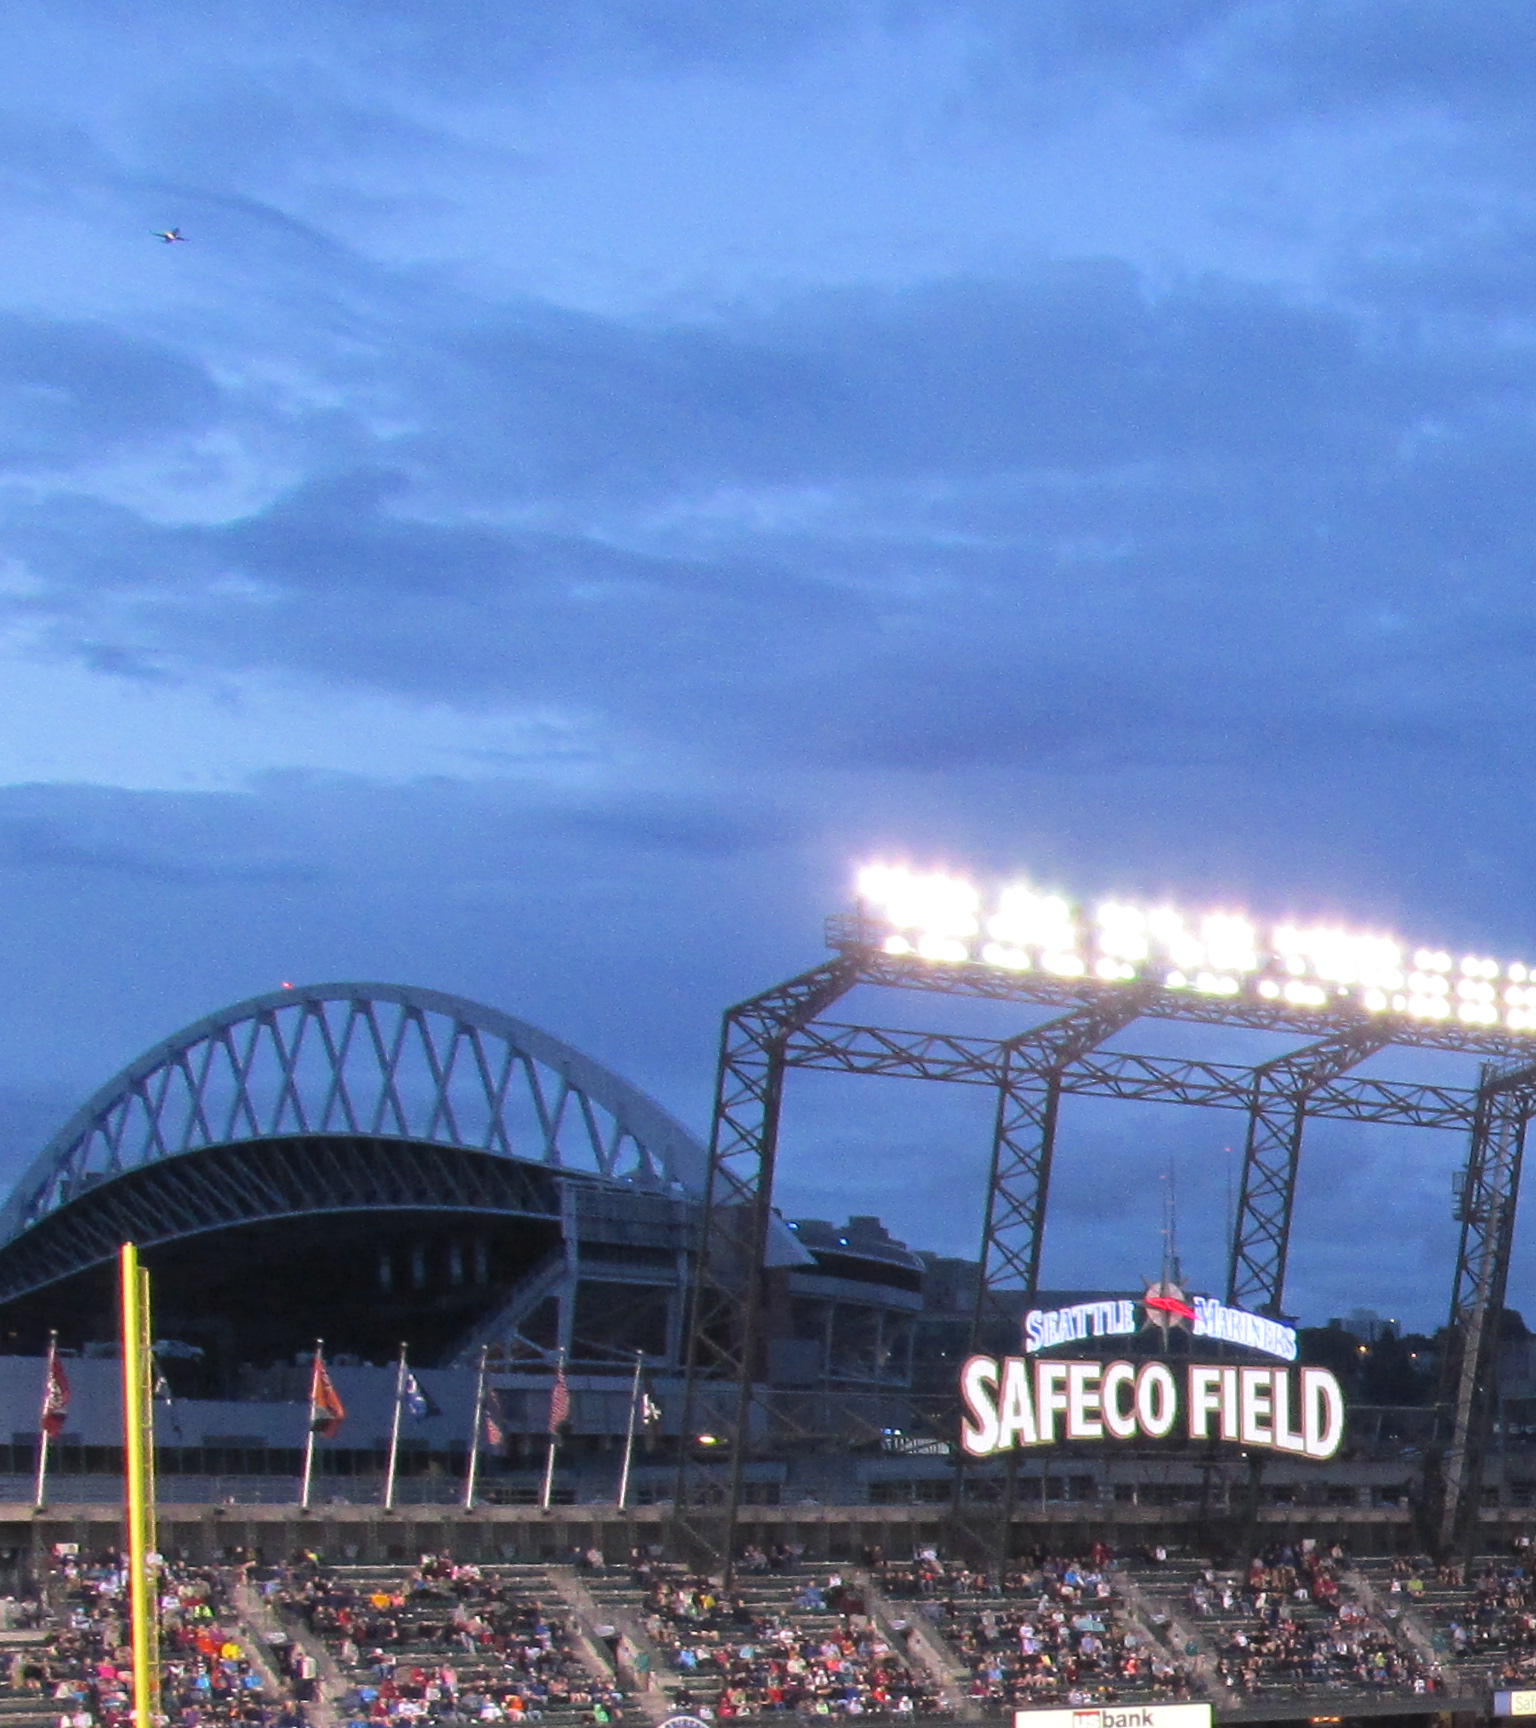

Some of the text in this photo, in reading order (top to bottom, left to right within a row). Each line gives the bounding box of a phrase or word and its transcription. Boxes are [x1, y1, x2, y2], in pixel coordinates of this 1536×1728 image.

[1026, 1297, 1298, 1360] SEATTLE MARINERS
[960, 1355, 1345, 1459] SAFECO FIELD
